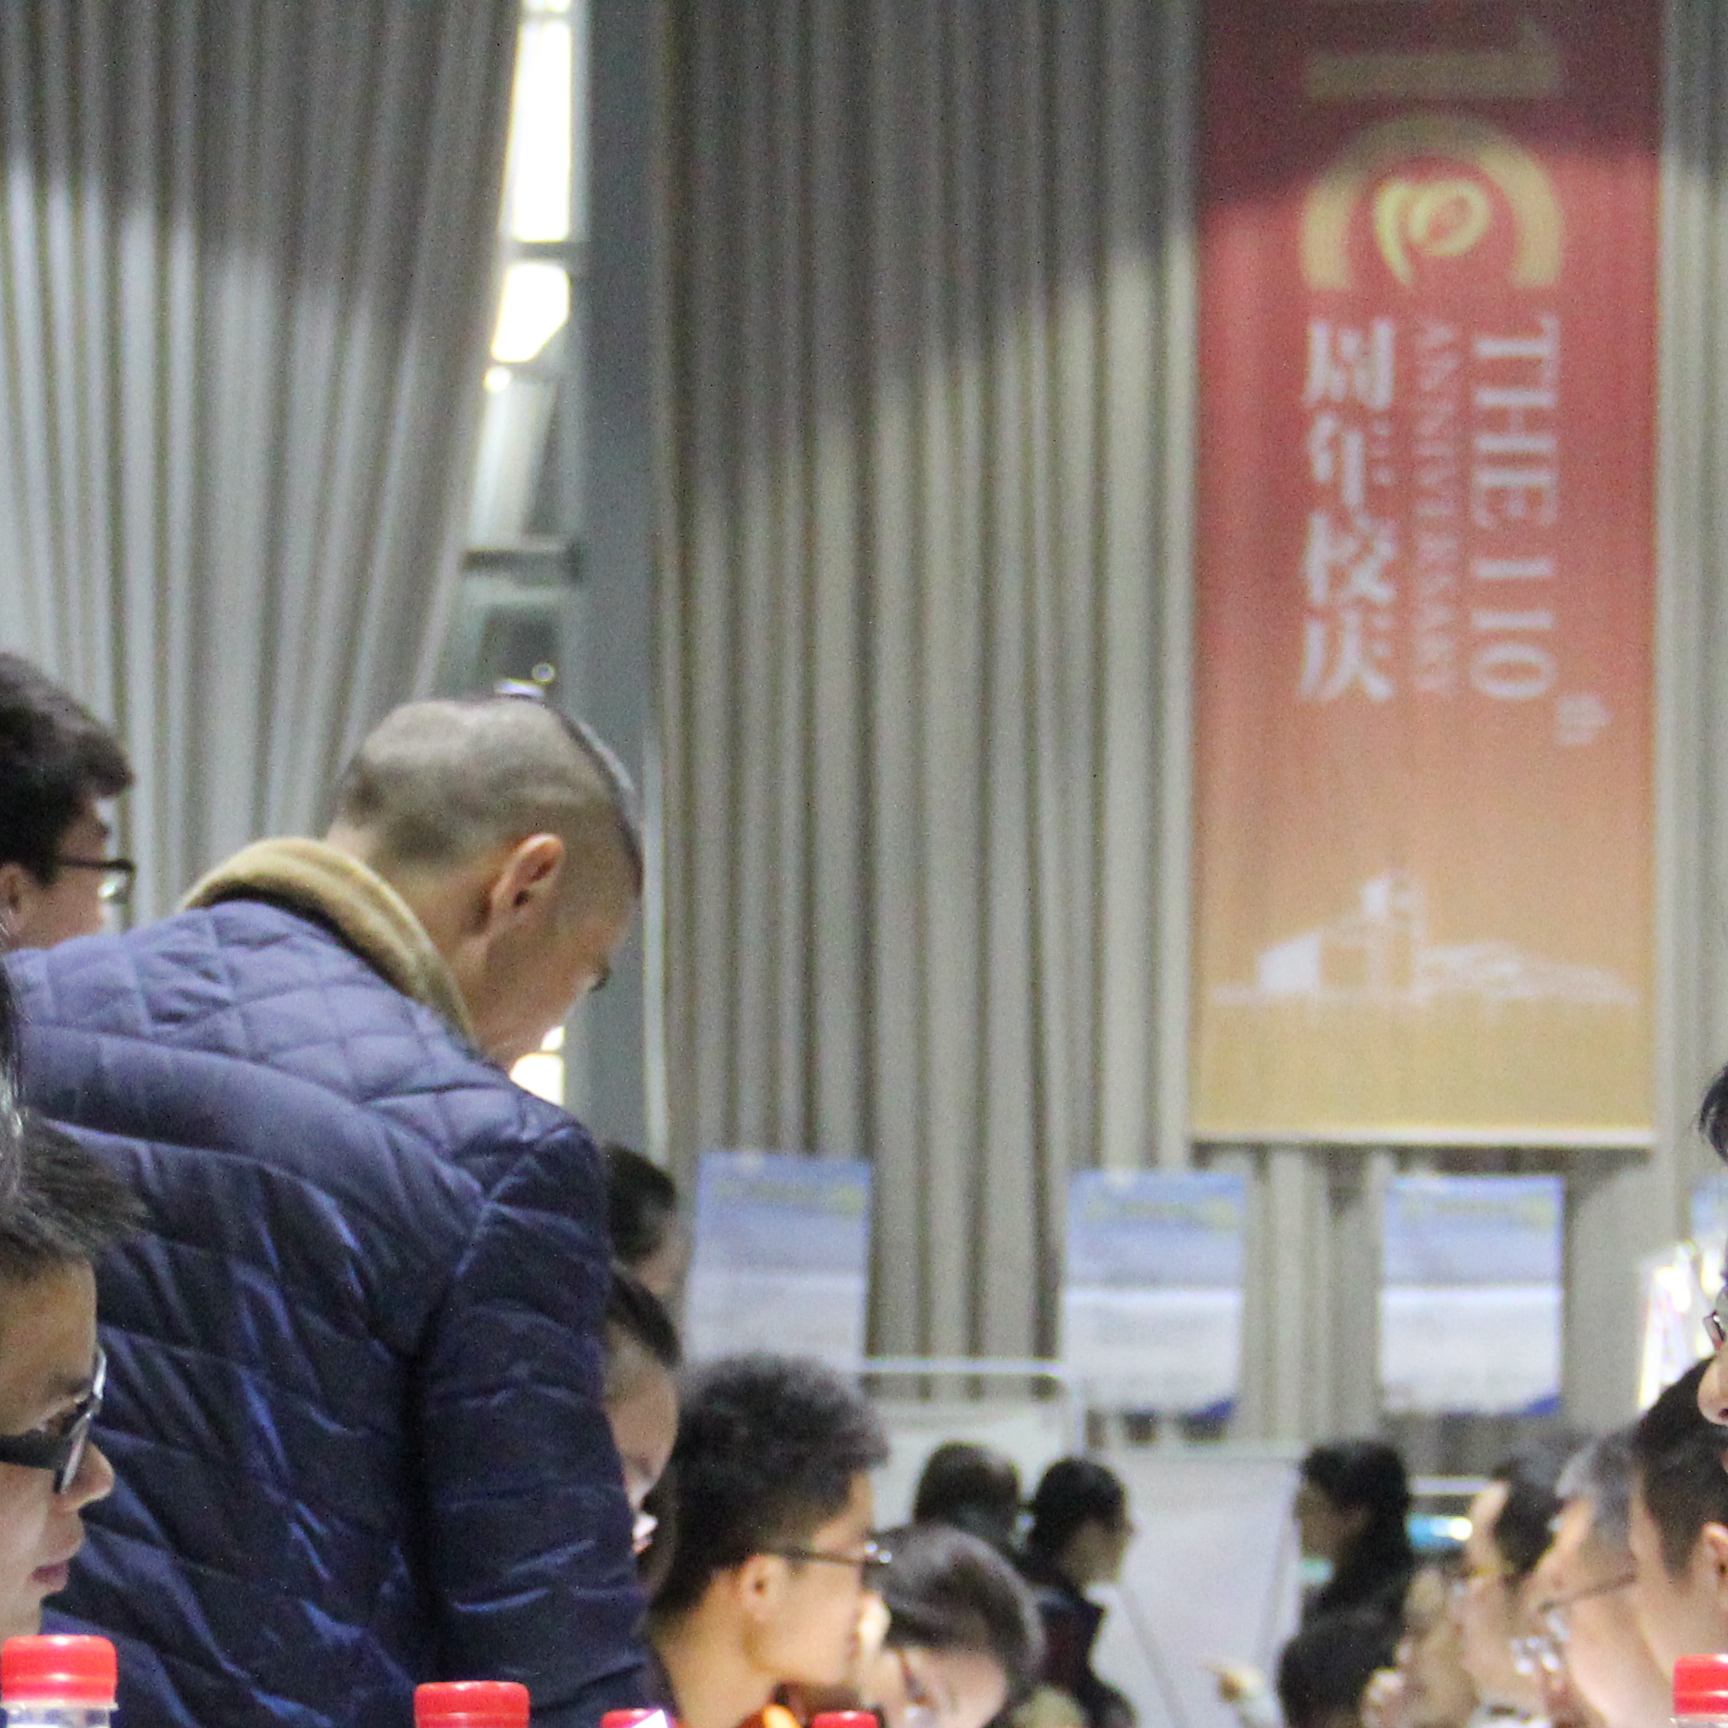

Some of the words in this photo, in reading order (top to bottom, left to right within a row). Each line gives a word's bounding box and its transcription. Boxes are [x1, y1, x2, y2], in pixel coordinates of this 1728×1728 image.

[1296, 317, 1398, 702] 周年校庆
[1473, 315, 1561, 528] THE
